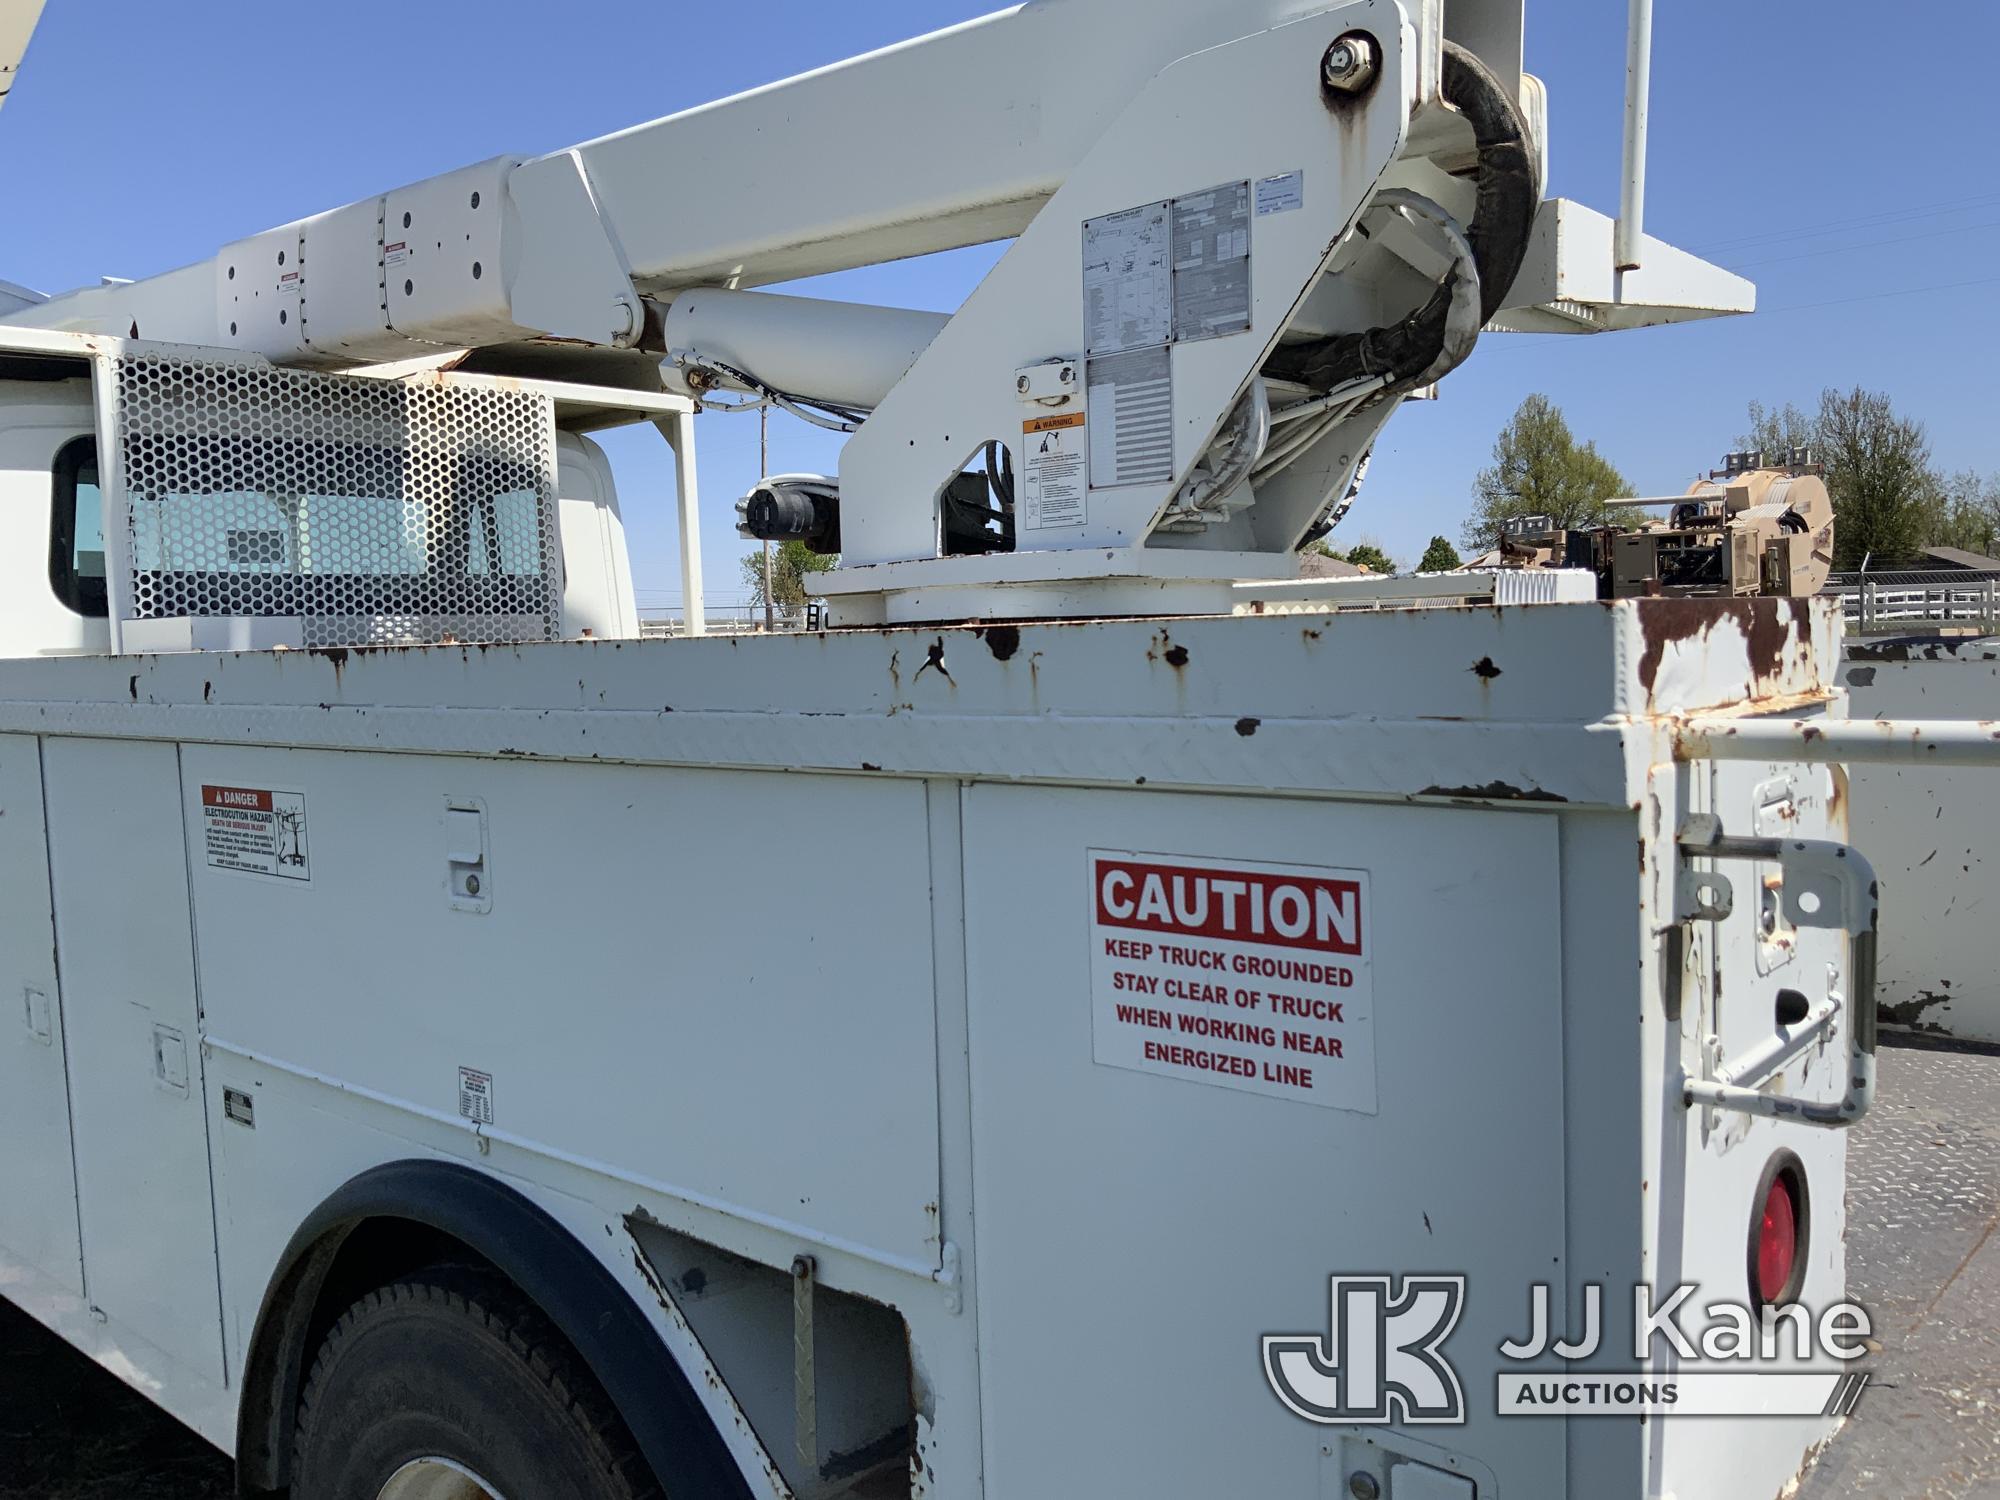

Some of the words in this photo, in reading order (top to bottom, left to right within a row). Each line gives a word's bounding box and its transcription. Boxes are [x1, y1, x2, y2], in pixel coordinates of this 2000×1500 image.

[1042, 418, 1072, 428] WARNING
[205, 808, 248, 820] ELECTROCUTION
[250, 813, 272, 823] HAZARD
[224, 792, 258, 806] DANGER
[1102, 870, 1356, 944] CAUTION
[1105, 939, 1153, 960] KEEP
[1159, 946, 1226, 971] TRUCK
[1232, 955, 1353, 987] GROUNDED
[1113, 972, 1159, 994] STAY
[1165, 980, 1228, 1005] CLEAR
[1234, 989, 1261, 1009] OF
[1268, 994, 1344, 1022] TRUCK
[1116, 1004, 1172, 1030] WHEN
[1177, 1014, 1275, 1047] WORKING
[1283, 1031, 1343, 1058] NEAR
[1144, 1041, 1256, 1077] ENERGIZED
[1264, 1063, 1313, 1088] LINE
